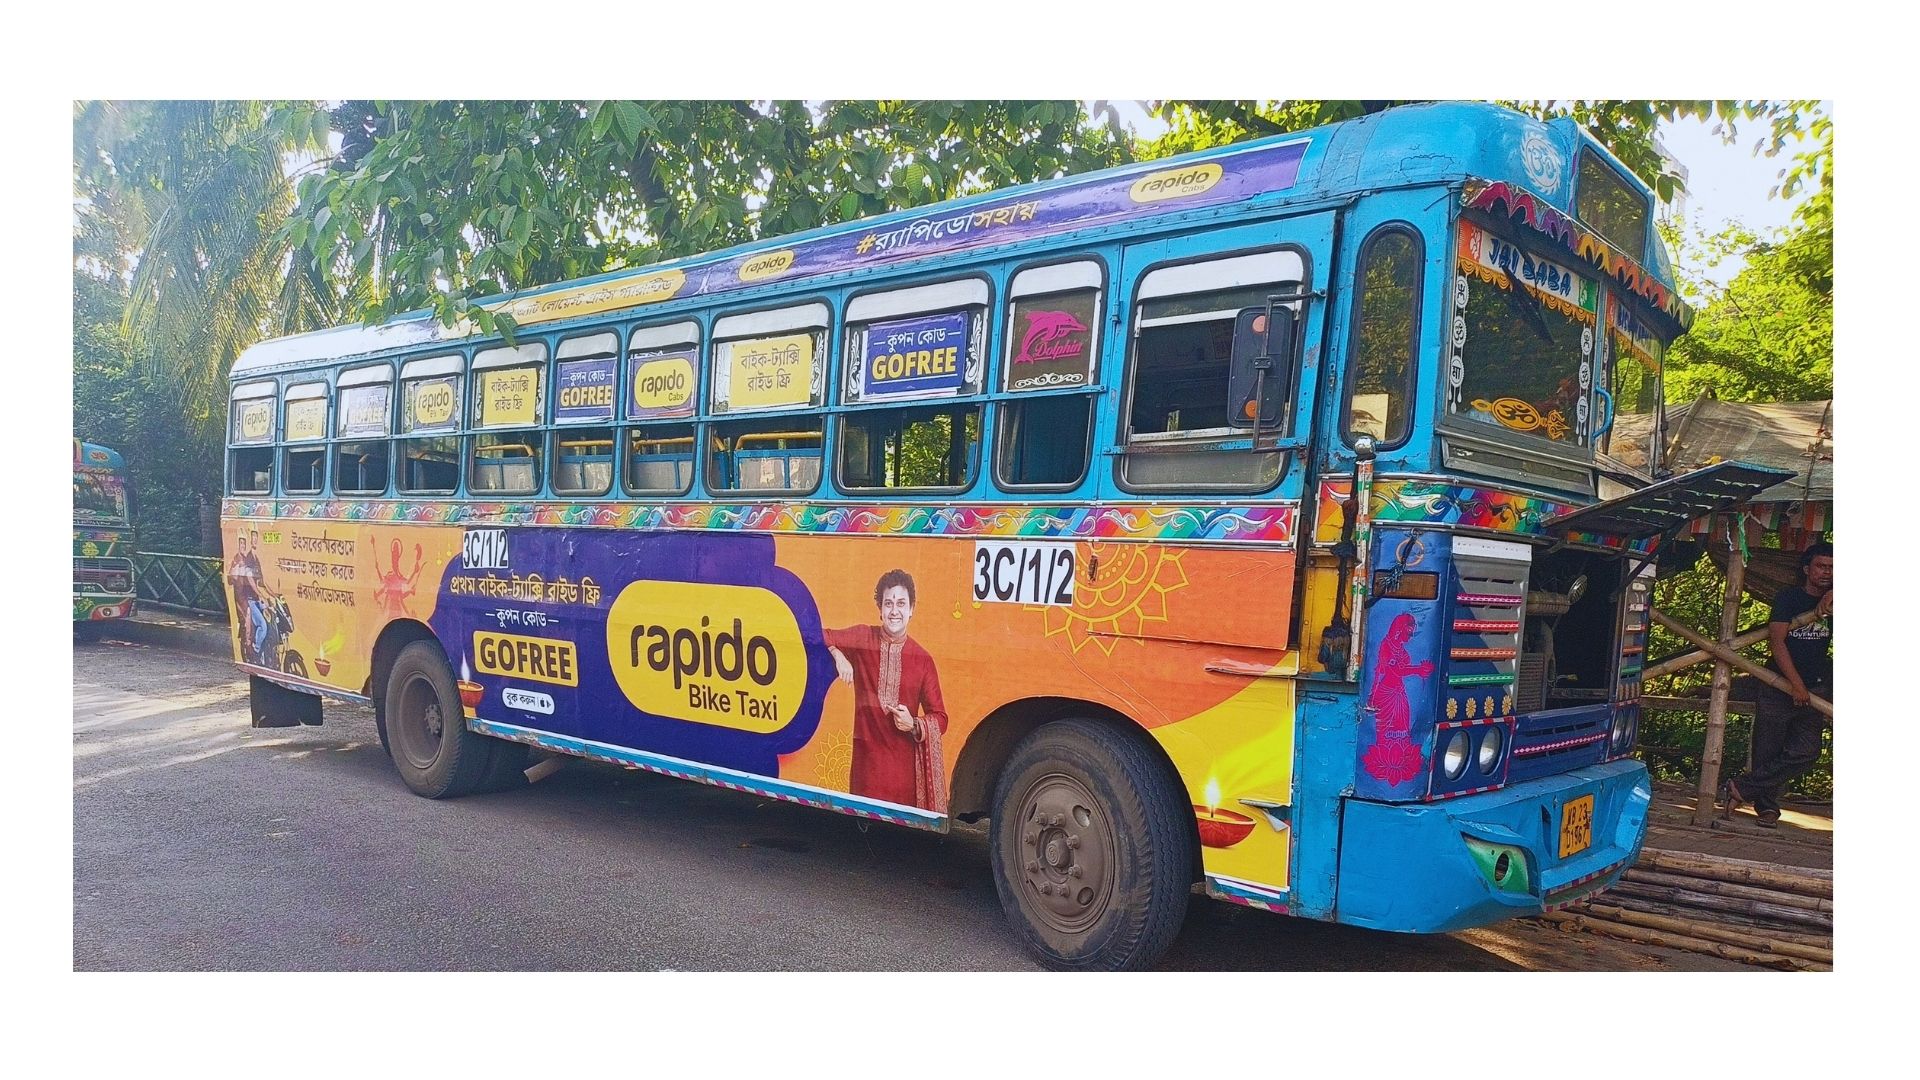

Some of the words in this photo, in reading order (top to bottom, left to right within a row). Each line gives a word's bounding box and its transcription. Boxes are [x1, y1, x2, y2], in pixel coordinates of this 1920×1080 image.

[1140, 171, 1210, 192] rapido
[1181, 185, 1205, 193] Cabs
[745, 256, 786, 273] rapido
[1489, 238, 1520, 274] JAI
[1522, 253, 1572, 297] BABA
[887, 331, 915, 353] কুপন
[917, 327, 947, 345] কোড
[1033, 339, 1083, 360] Dolphin
[741, 344, 801, 369] বাইক-ট্যাক্সি
[872, 347, 957, 380] GOFREE
[569, 370, 587, 387] কুপন
[588, 369, 606, 382] কোড
[641, 369, 684, 397] rapido
[747, 371, 773, 392] রাইড
[775, 368, 791, 391] ফ্রি
[418, 388, 449, 412] rapido
[495, 396, 511, 411] রাইড
[560, 385, 612, 407] GOFREE
[668, 392, 684, 402] Cabs
[245, 408, 266, 428] rapido
[291, 530, 322, 553] উৎসবের
[463, 532, 508, 567] 3C/1/2
[309, 561, 328, 577] সহজ
[330, 563, 355, 580] করতে
[974, 547, 1075, 604] 3C/1/2
[450, 575, 475, 596] প্রথম
[478, 571, 544, 602] বাইক-ট্যাক্সি
[547, 575, 578, 604] রাইড
[581, 576, 601, 607] ফ্রি
[496, 608, 520, 628] কুপন
[523, 610, 547, 627] কোড
[480, 637, 572, 680] GOFREE
[631, 616, 777, 690] rapido
[506, 692, 518, 705] বুক
[519, 694, 535, 706] করুন
[689, 683, 731, 713] Bike
[735, 690, 778, 721] Taxi
